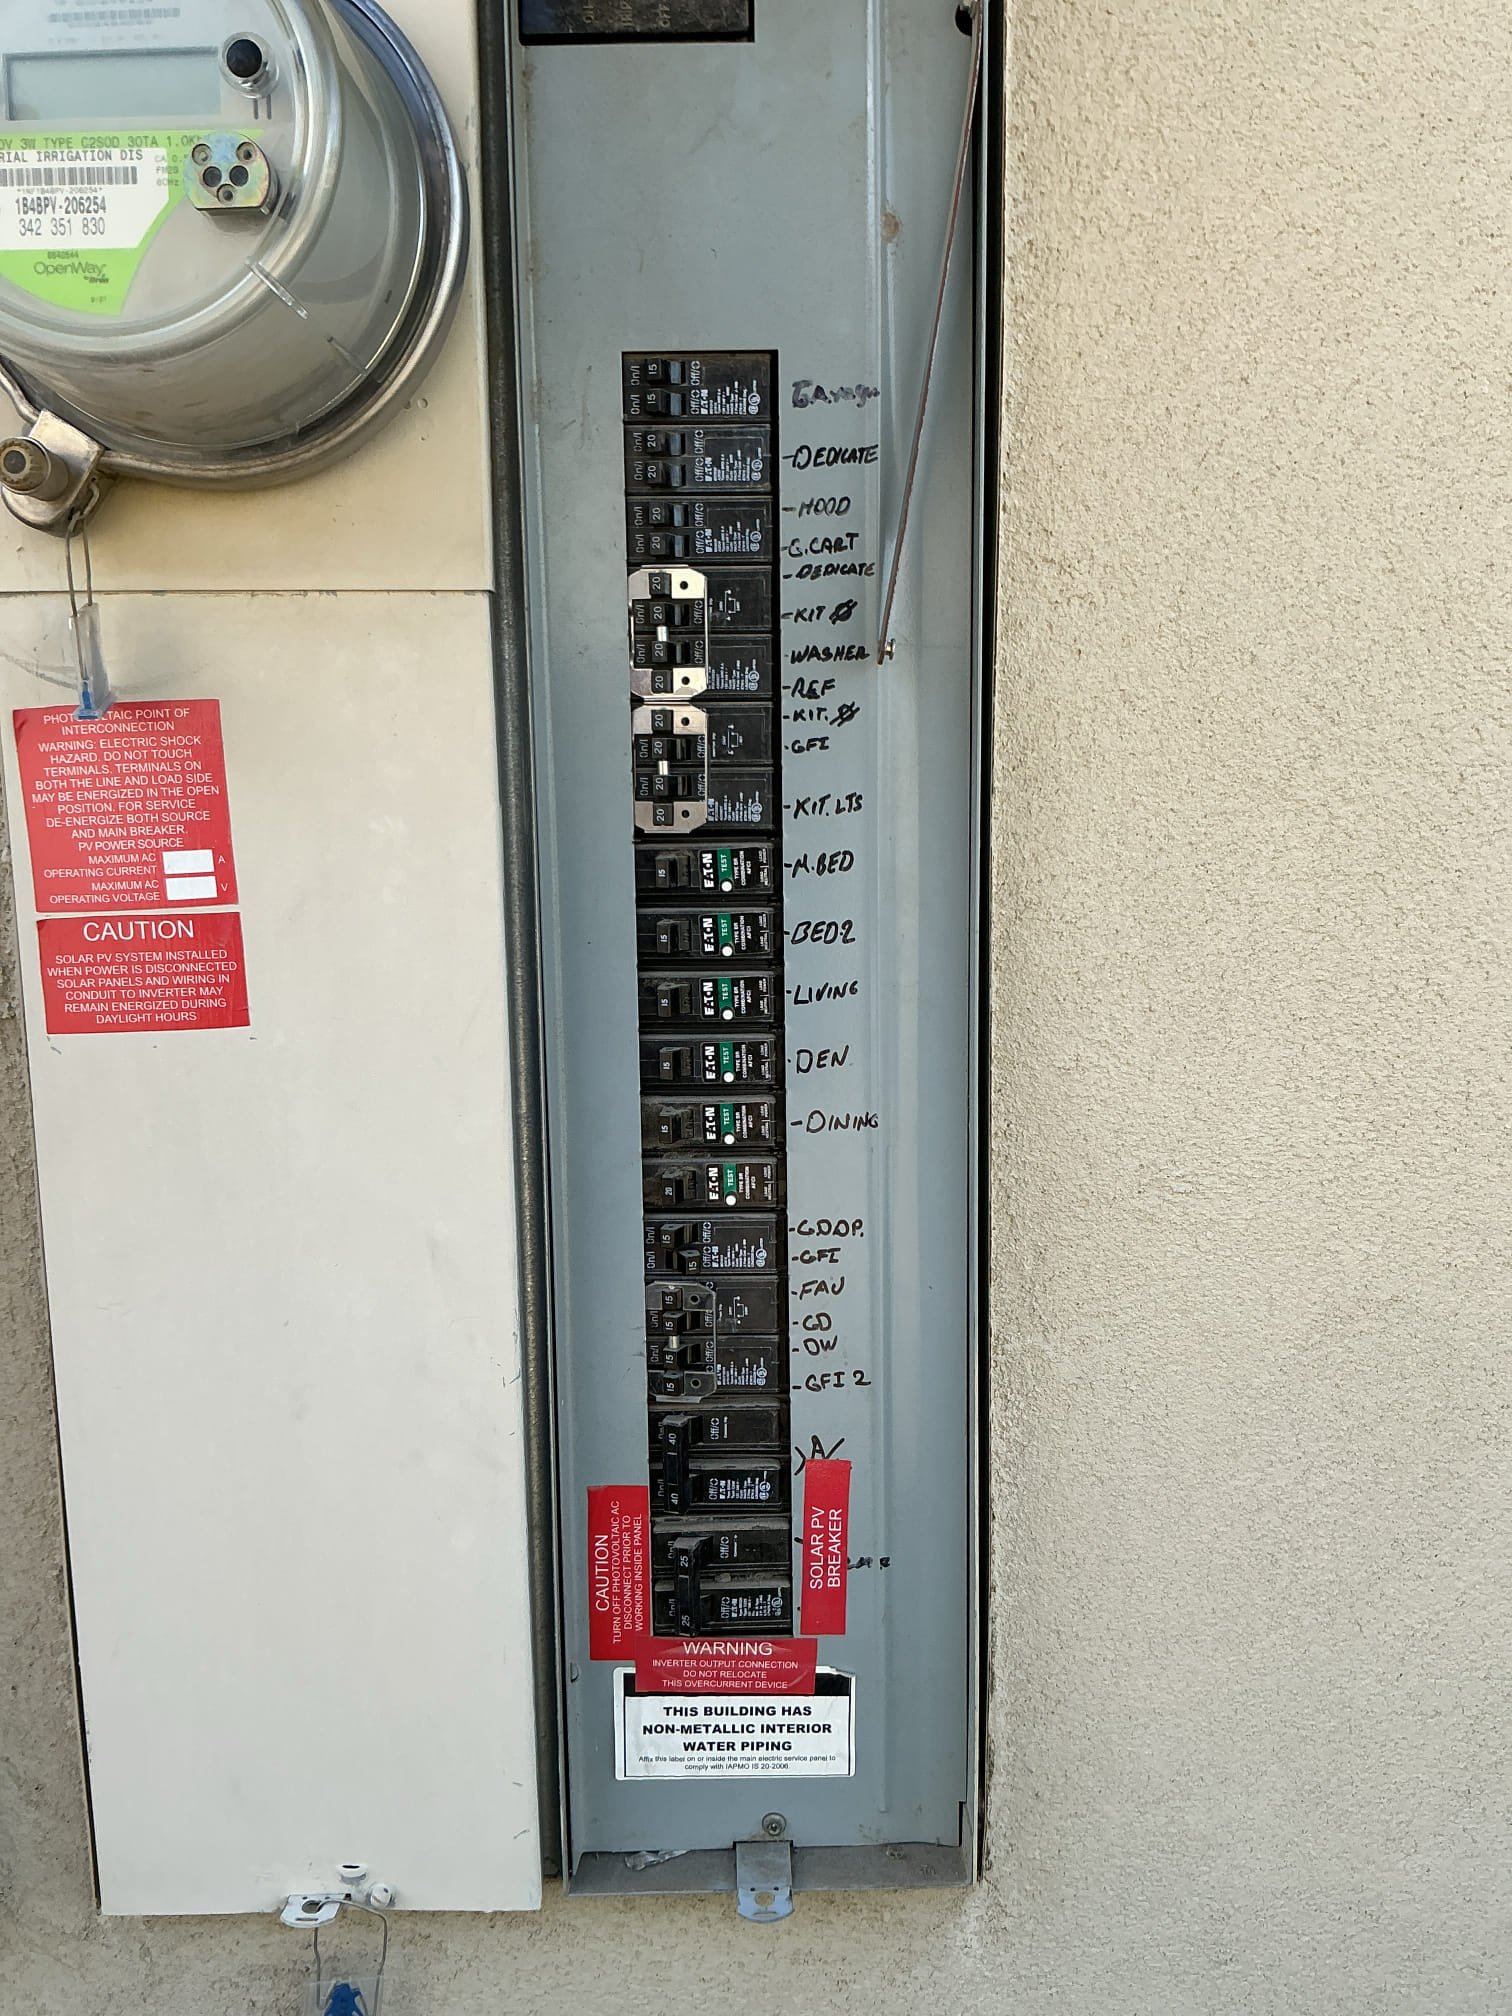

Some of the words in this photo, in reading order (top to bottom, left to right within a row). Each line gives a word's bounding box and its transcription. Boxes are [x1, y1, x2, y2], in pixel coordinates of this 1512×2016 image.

[44, 137, 73, 148] TYPE
[37, 151, 112, 161] IRRIGATION
[121, 150, 143, 160] DIS
[19, 218, 41, 236] 342
[51, 218, 72, 235] 351
[82, 217, 105, 235] 830
[34, 261, 104, 275] OpenWay
[648, 394, 656, 403] 15
[44, 710, 132, 724] PHOTLTAIC
[136, 709, 169, 719] POINT
[175, 708, 190, 718] OF
[62, 721, 175, 735] INTERCONNECTION
[39, 740, 96, 753] WARNING:
[100, 738, 156, 749] ELECTRIC
[161, 736, 201, 746] SHOCK
[50, 753, 100, 764] HAZARD.
[104, 752, 120, 762] DO
[124, 751, 147, 760] NOT
[152, 749, 192, 759] TOUCH
[44, 765, 112, 777] TERMINALS.
[115, 762, 181, 774] TERMINALS
[184, 761, 202, 771] ON
[36, 780, 67, 790] BOTH
[70, 778, 92, 789] THE
[96, 777, 121, 787] LINE
[124, 776, 148, 786] AND
[152, 774, 183, 785] LOAD
[186, 773, 212, 783] SIDE
[32, 793, 55, 803] MAY
[59, 792, 73, 802] BE
[77, 789, 144, 801] ENERGIZED
[147, 788, 158, 797] IN
[161, 787, 184, 797] THE
[187, 785, 219, 796] OPEN
[58, 803, 113, 814] POSITION.
[119, 801, 143, 811] FOR
[146, 799, 196, 810] SERVICE
[46, 815, 124, 827] DE-ENERGIZE
[127, 813, 158, 823] BOTH
[162, 811, 210, 822] SOURCE
[657, 809, 665, 821] 20
[72, 829, 95, 839] AND
[99, 827, 127, 837] MAIN
[130, 825, 187, 836] BREAKER.
[79, 842, 92, 852] PV
[95, 840, 137, 850] POWER
[139, 838, 184, 848] SOURCE
[89, 855, 140, 864] MAXIMUM
[142, 853, 156, 863] AC
[218, 855, 225, 864] A
[44, 868, 104, 878] OPERATING
[107, 866, 157, 876] CURRENT
[92, 881, 143, 891] MAXIMUM
[144, 880, 159, 889] AC
[221, 883, 228, 892] V
[50, 894, 110, 904] OPERATING
[112, 892, 160, 902] VOLTAGE
[83, 920, 194, 941] CAUTION
[56, 954, 94, 964] SOLAR
[97, 954, 112, 963] PV
[115, 952, 162, 963] SYSTEM
[166, 950, 227, 961] INSTALLED
[47, 967, 82, 977] WHEN
[86, 965, 128, 976] POWER
[132, 965, 142, 974] IS
[146, 962, 237, 974] DISCONNECTED
[57, 979, 95, 989] SOLAR
[99, 977, 143, 987] PANELS
[146, 976, 170, 985] AND
[173, 974, 215, 984] WIRING
[219, 974, 230, 983] IN
[66, 990, 116, 1001] CONDUIT
[120, 989, 136, 999] TO
[139, 988, 197, 998] INVERTER
[200, 986, 223, 996] MAY
[65, 1003, 109, 1012] REMAIN
[112, 1000, 179, 1011] ENERGIZED
[182, 998, 227, 1009] DURING
[96, 1013, 152, 1024] DAYLIGHT
[155, 1012, 197, 1022] HOURS
[853, 1370, 871, 1386] 2
[611, 1500, 619, 1514] AC
[622, 1515, 630, 1528] TO
[811, 1506, 824, 1528] PV
[633, 1514, 642, 1545] PANEL
[611, 1517, 620, 1592] PHOTOVOLTAIC
[623, 1532, 631, 1562] PRIOR
[827, 1509, 842, 1587] BREAKER
[634, 1549, 643, 1581] INSIDE
[680, 1555, 689, 1568] 25
[810, 1534, 823, 1589] SOLAR
[595, 1535, 609, 1611] CAUTION
[612, 1595, 620, 1614] OFF
[624, 1566, 632, 1629] DISCONNECT
[634, 1584, 643, 1631] WORKING
[613, 1617, 621, 1644] TURN
[683, 1641, 773, 1655] WARNING
[653, 1660, 697, 1668] INVERTER
[738, 1661, 798, 1669] CONNECTION
[699, 1670, 717, 1678] NOT
[720, 1671, 767, 1679] RELOCATE
[685, 1680, 753, 1688] OVERCURRENT
[755, 1681, 788, 1689] DEVICE
[663, 1706, 699, 1717] THIS
[703, 1706, 777, 1716] BUILDING
[782, 1706, 812, 1716] HAS
[643, 1724, 755, 1734] NON-METALLIC
[761, 1723, 832, 1733] INTERIOR
[683, 1741, 735, 1751] WATER
[741, 1741, 792, 1751] PIPING
